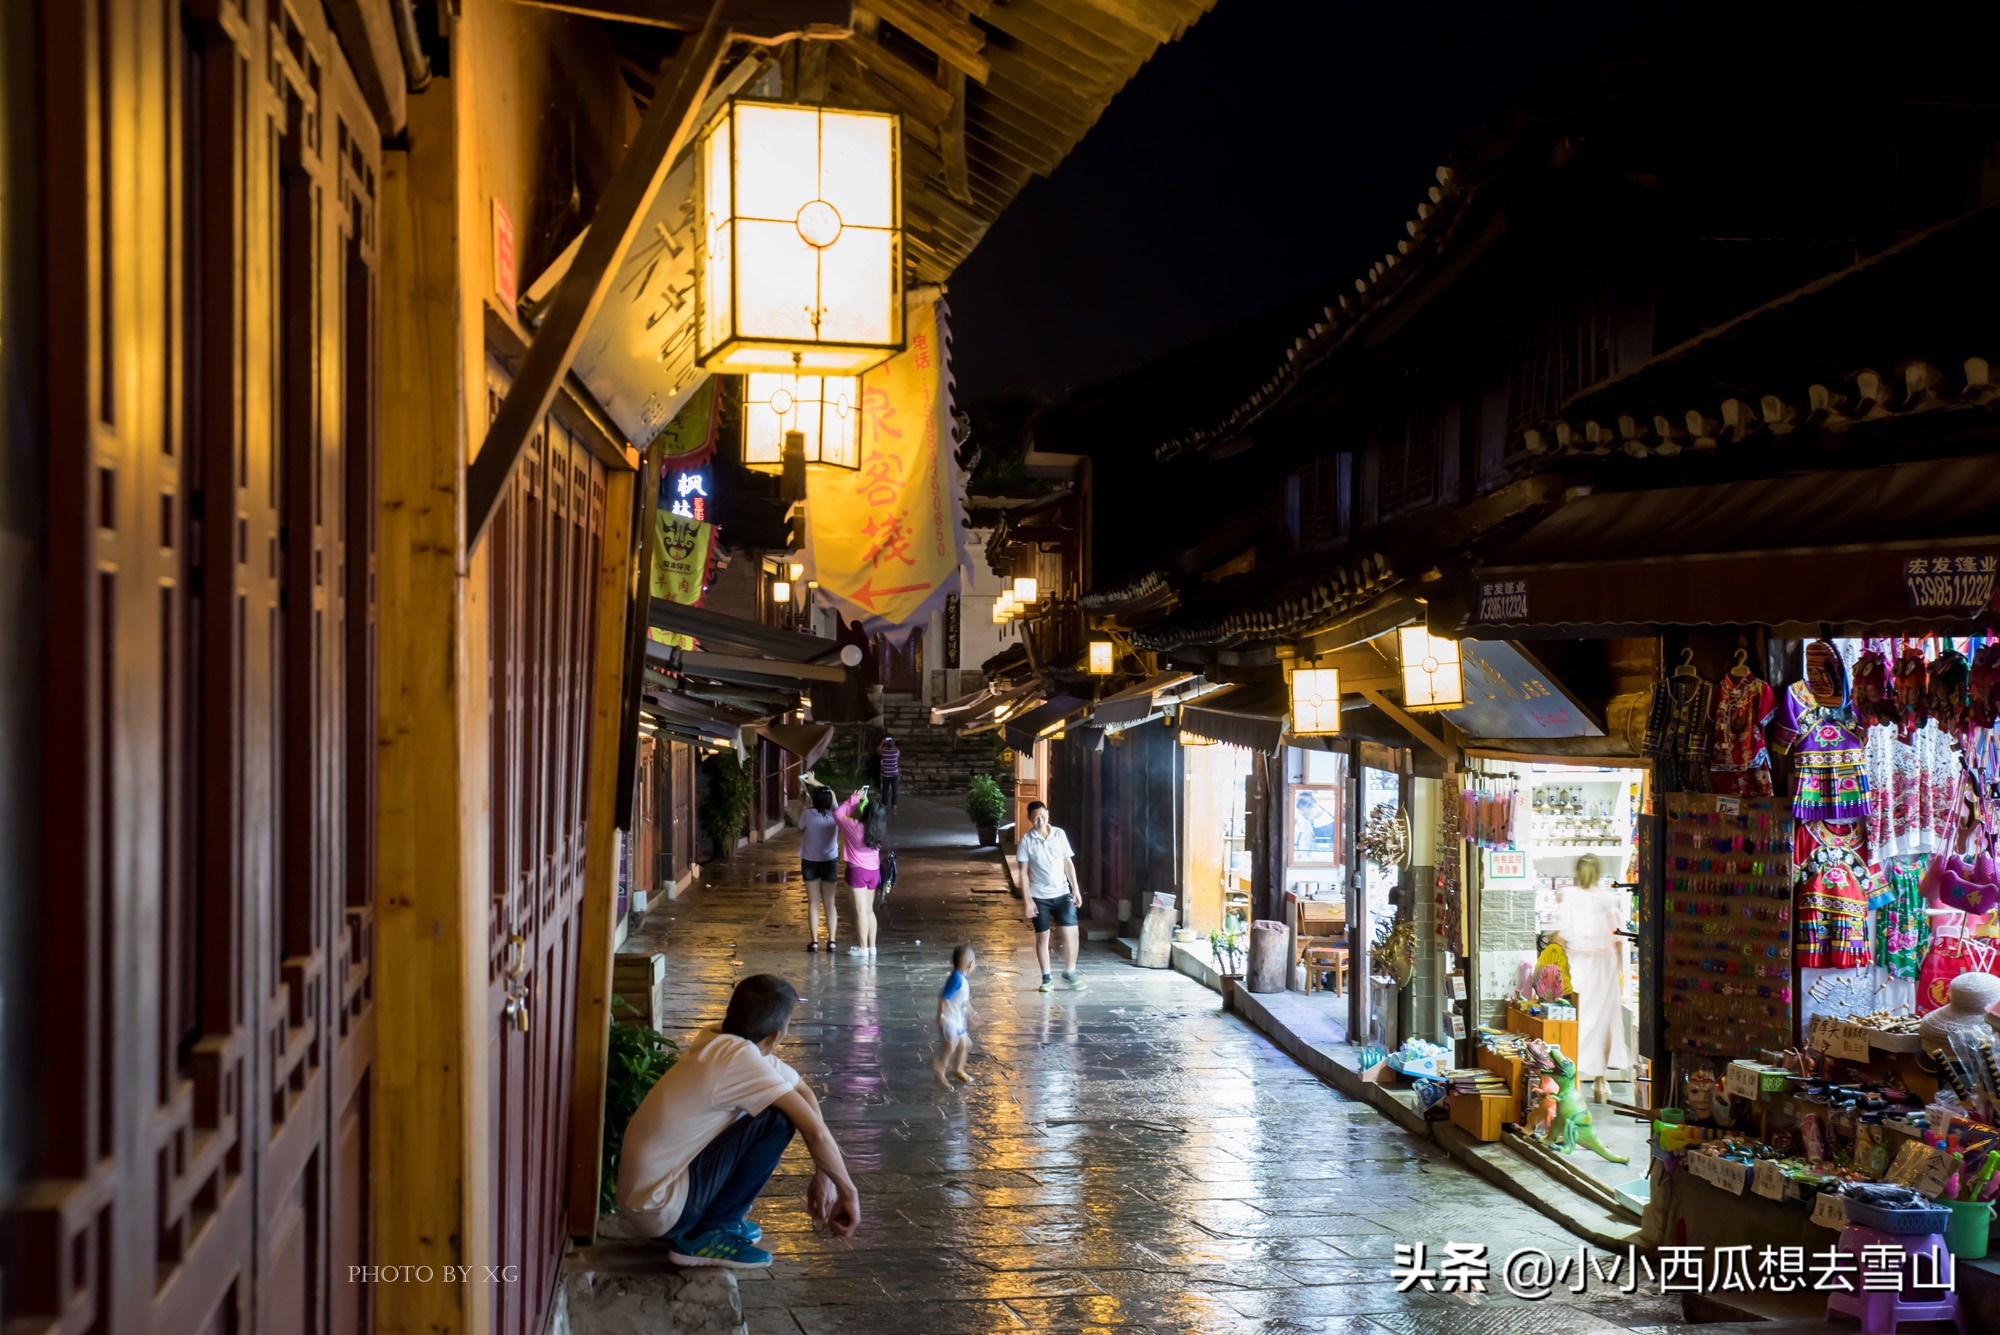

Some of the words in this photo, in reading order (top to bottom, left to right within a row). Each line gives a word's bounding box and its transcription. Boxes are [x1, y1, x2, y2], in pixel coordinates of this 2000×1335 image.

[856, 359, 915, 567] 泉客栈
[1908, 556, 1997, 575] 宏发篷业
[1493, 854, 1522, 864] 内有监控
[1496, 865, 1518, 874] 请自重
